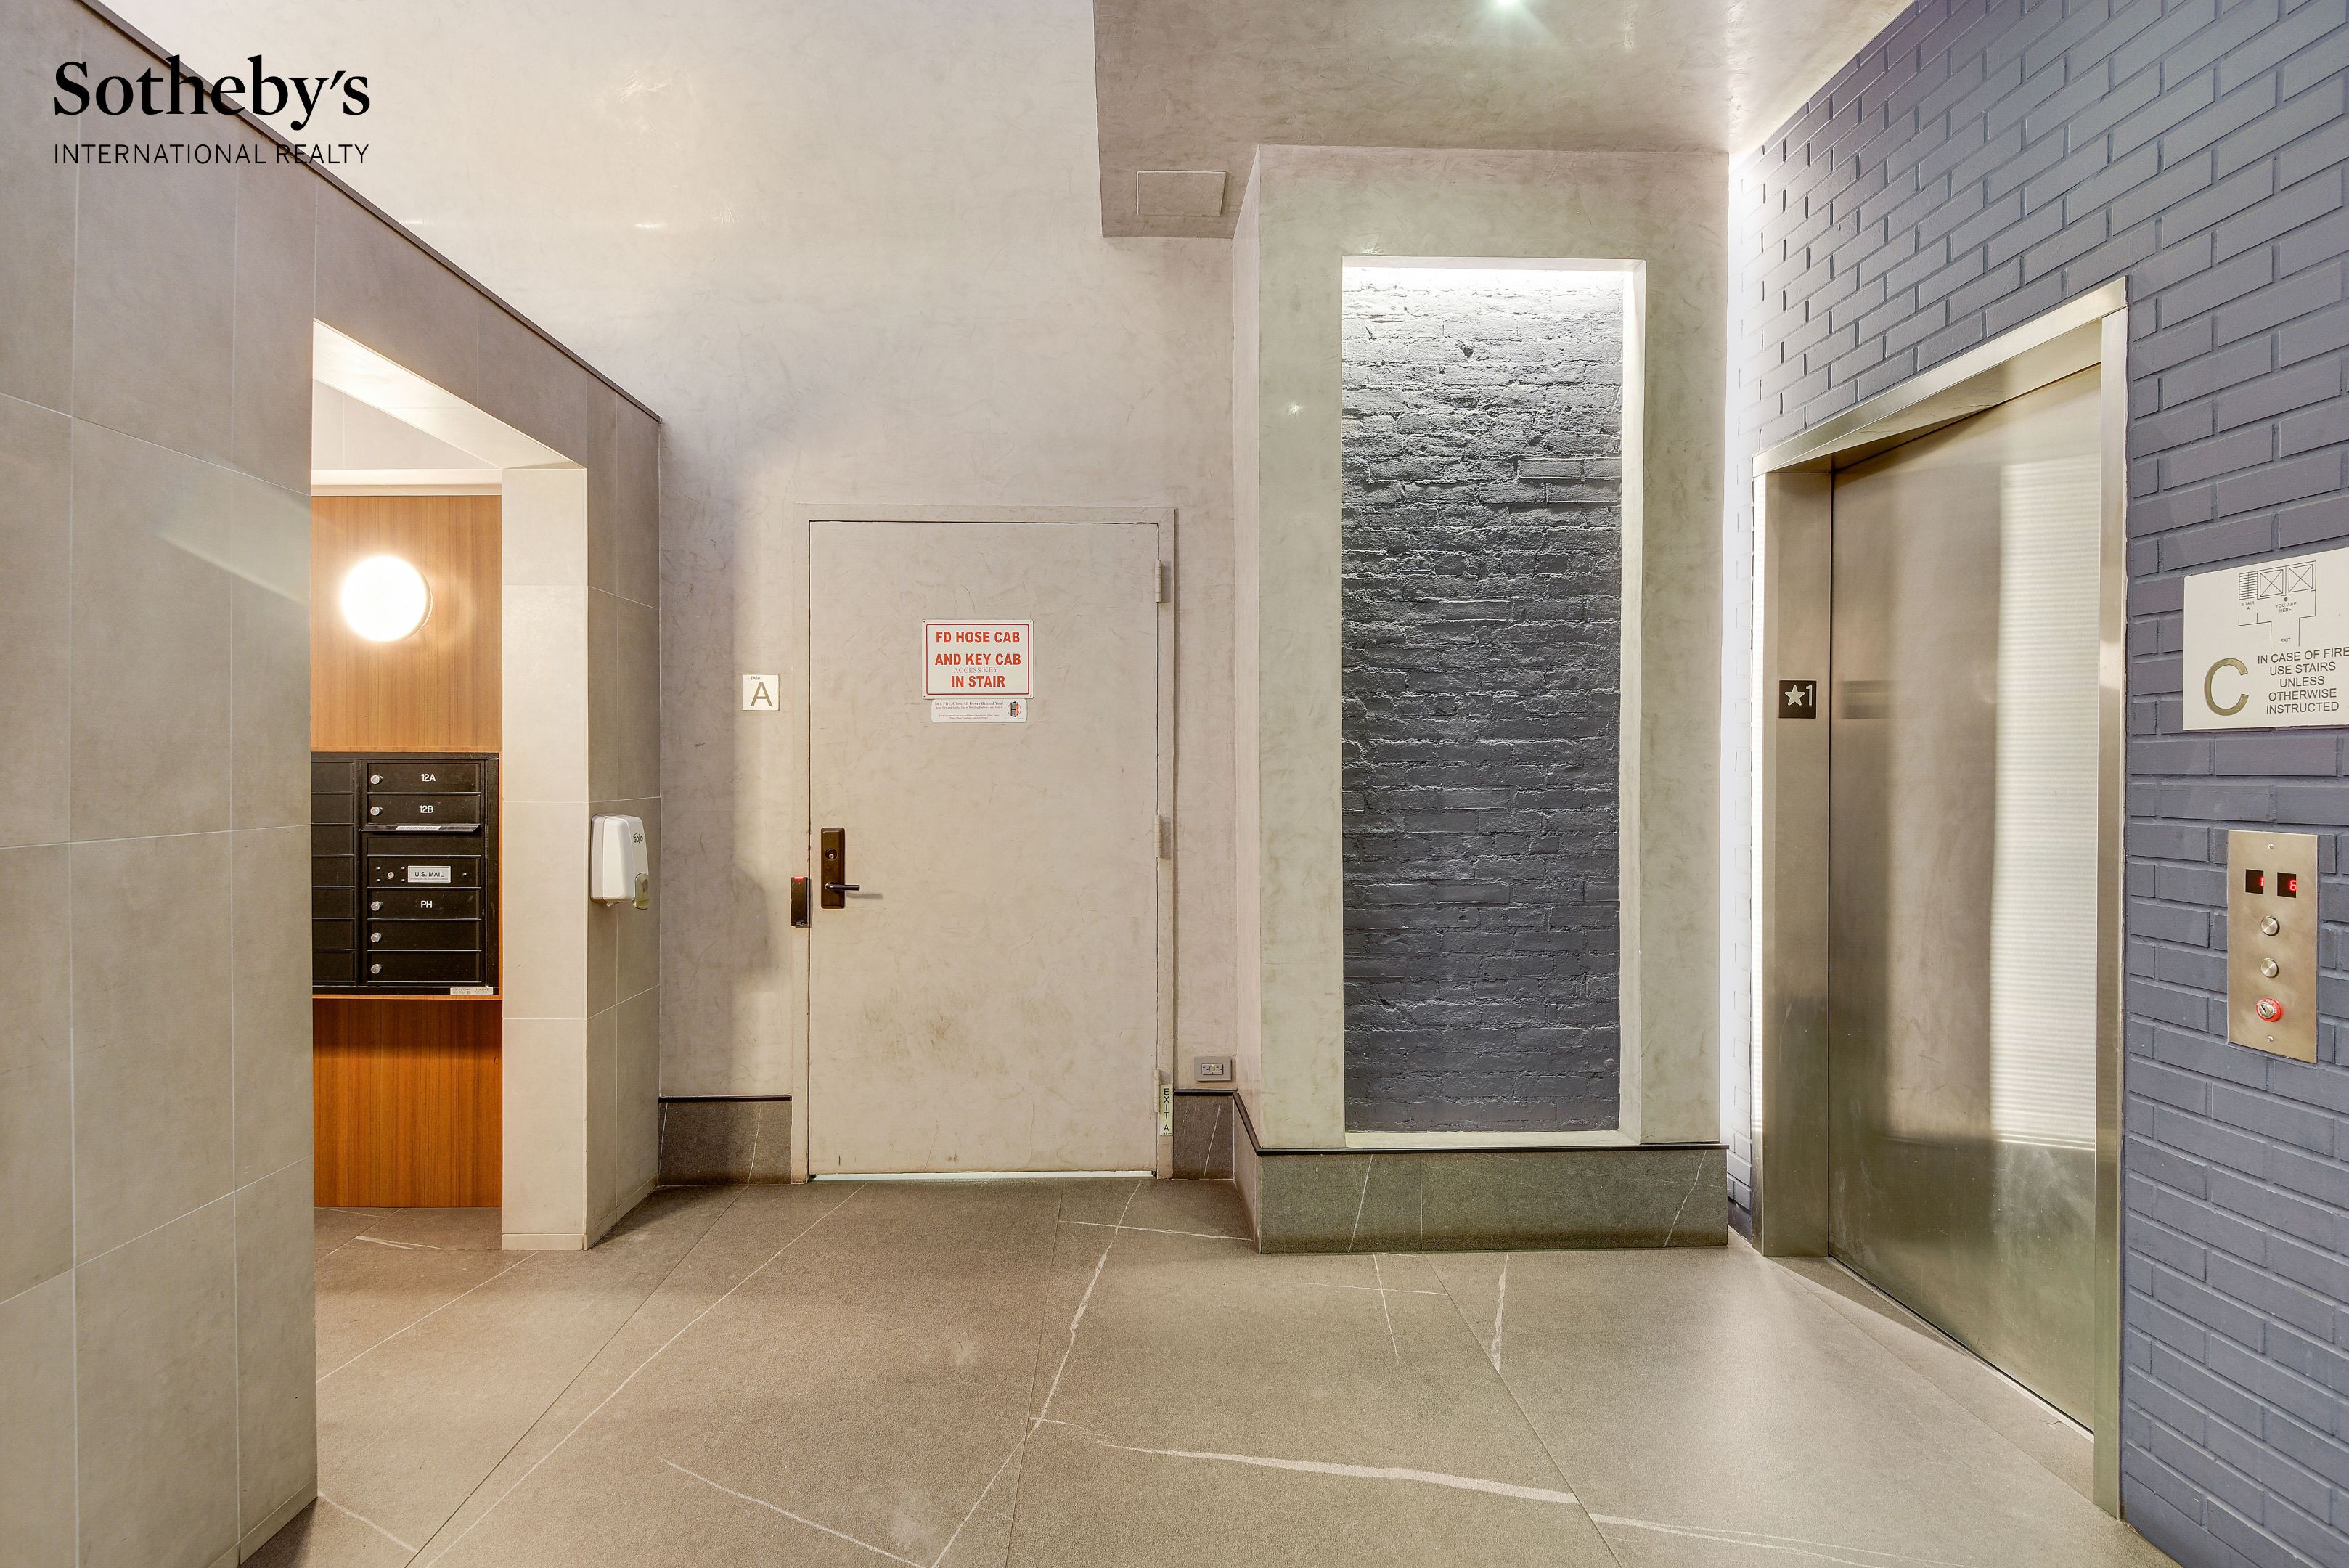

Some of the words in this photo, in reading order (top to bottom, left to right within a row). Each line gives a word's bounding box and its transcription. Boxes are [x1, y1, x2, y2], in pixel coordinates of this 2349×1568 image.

[936, 631, 952, 643] FD
[955, 631, 990, 643] HOSE
[994, 631, 1021, 643] CAB
[935, 653, 962, 666] AND
[965, 653, 992, 666] KEY
[995, 653, 1021, 666] CAB
[2258, 654, 2268, 664] IN
[2271, 651, 2301, 663] CASE
[2304, 649, 2320, 660] OF
[2324, 646, 2349, 658] FIRE
[2270, 665, 2292, 675] USE
[2295, 661, 2336, 674] STAIRS
[951, 676, 964, 687] IN
[968, 675, 1005, 687] STAIR
[2204, 658, 2249, 716] C
[2280, 675, 2325, 687] UNLESS
[751, 682, 773, 706] A
[1805, 685, 1813, 706] 1
[2268, 687, 2337, 701] OTHERWISE
[2266, 701, 2339, 714] INSTRUCTED
[421, 773, 436, 782] 12A
[419, 805, 434, 814] 12B
